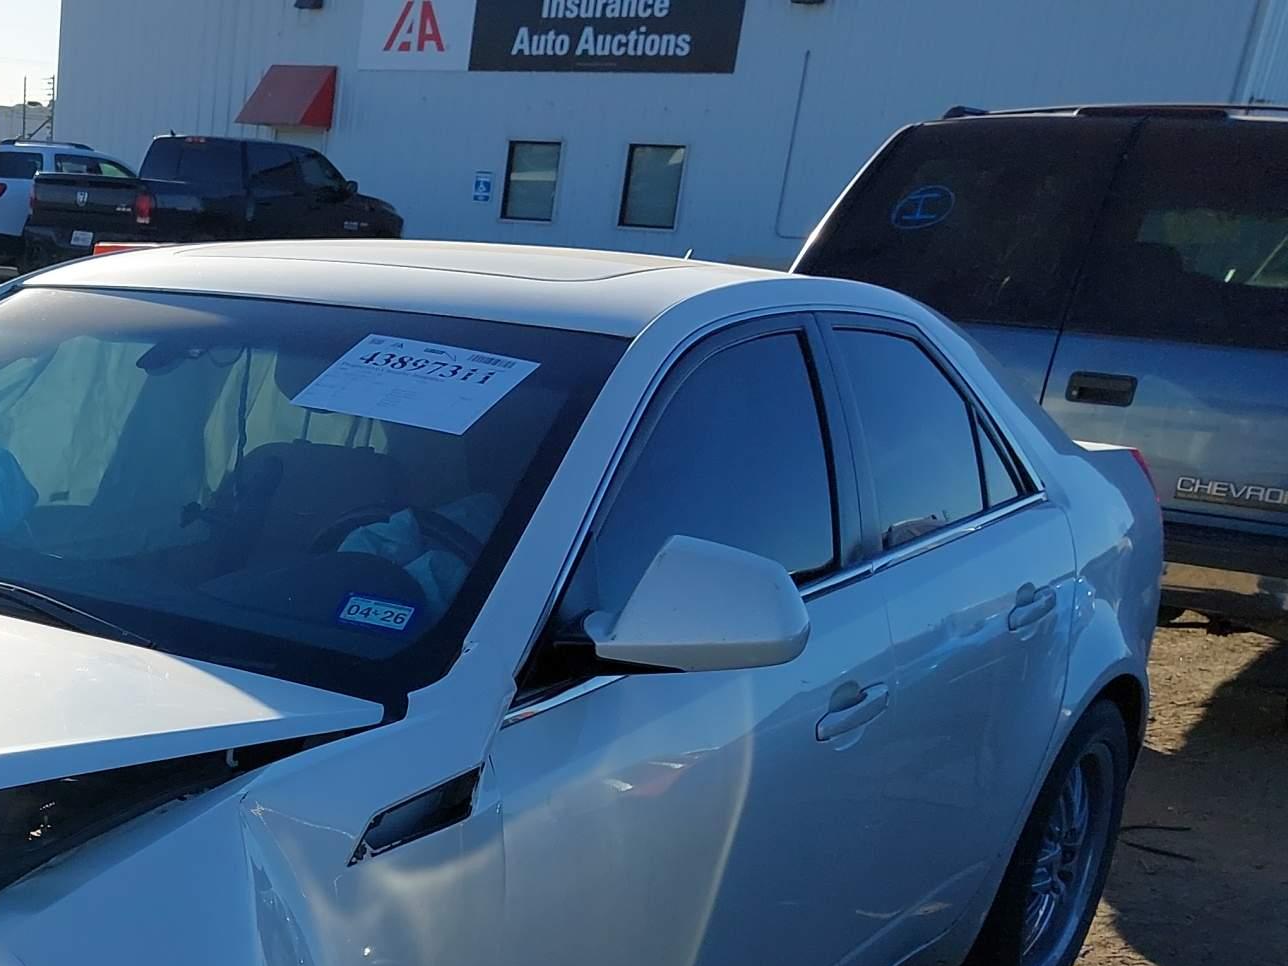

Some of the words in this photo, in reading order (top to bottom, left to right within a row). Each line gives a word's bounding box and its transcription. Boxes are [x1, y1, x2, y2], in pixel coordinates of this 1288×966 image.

[511, 27, 570, 56] Auto
[575, 26, 692, 56] Auctions
[1176, 477, 1288, 505] CHEVRO
